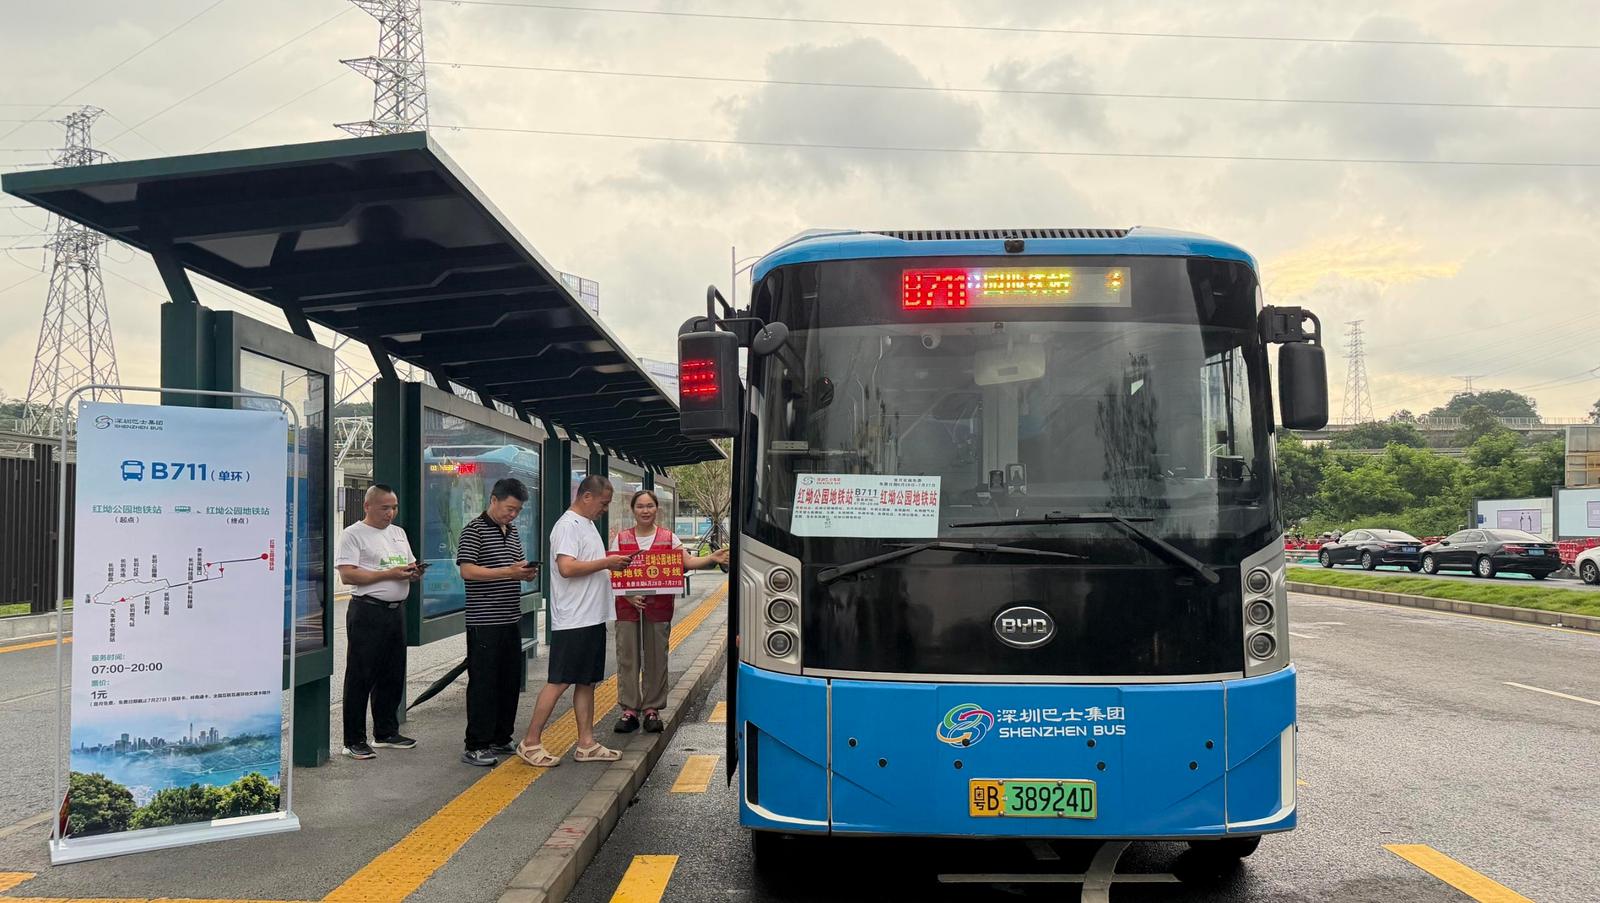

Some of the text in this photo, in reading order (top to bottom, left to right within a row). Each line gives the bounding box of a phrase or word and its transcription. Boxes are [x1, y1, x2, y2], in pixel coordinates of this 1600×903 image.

[904, 274, 966, 305] B711
[151, 461, 207, 481] B711
[797, 487, 938, 507] 红坳公园地铁站 B711 红坳公园地铁站
[92, 504, 270, 516] 红坳公园地铁站 红坳公园地铁站
[663, 567, 681, 577] 号线
[1001, 618, 1048, 634] BYD
[91, 662, 163, 675] 07:00-20:00
[90, 689, 108, 700] 1元
[997, 706, 1125, 723] 深圳巴士集团
[999, 726, 1126, 738] SHENZHEN BUS
[1011, 786, 1093, 813] 38924D
